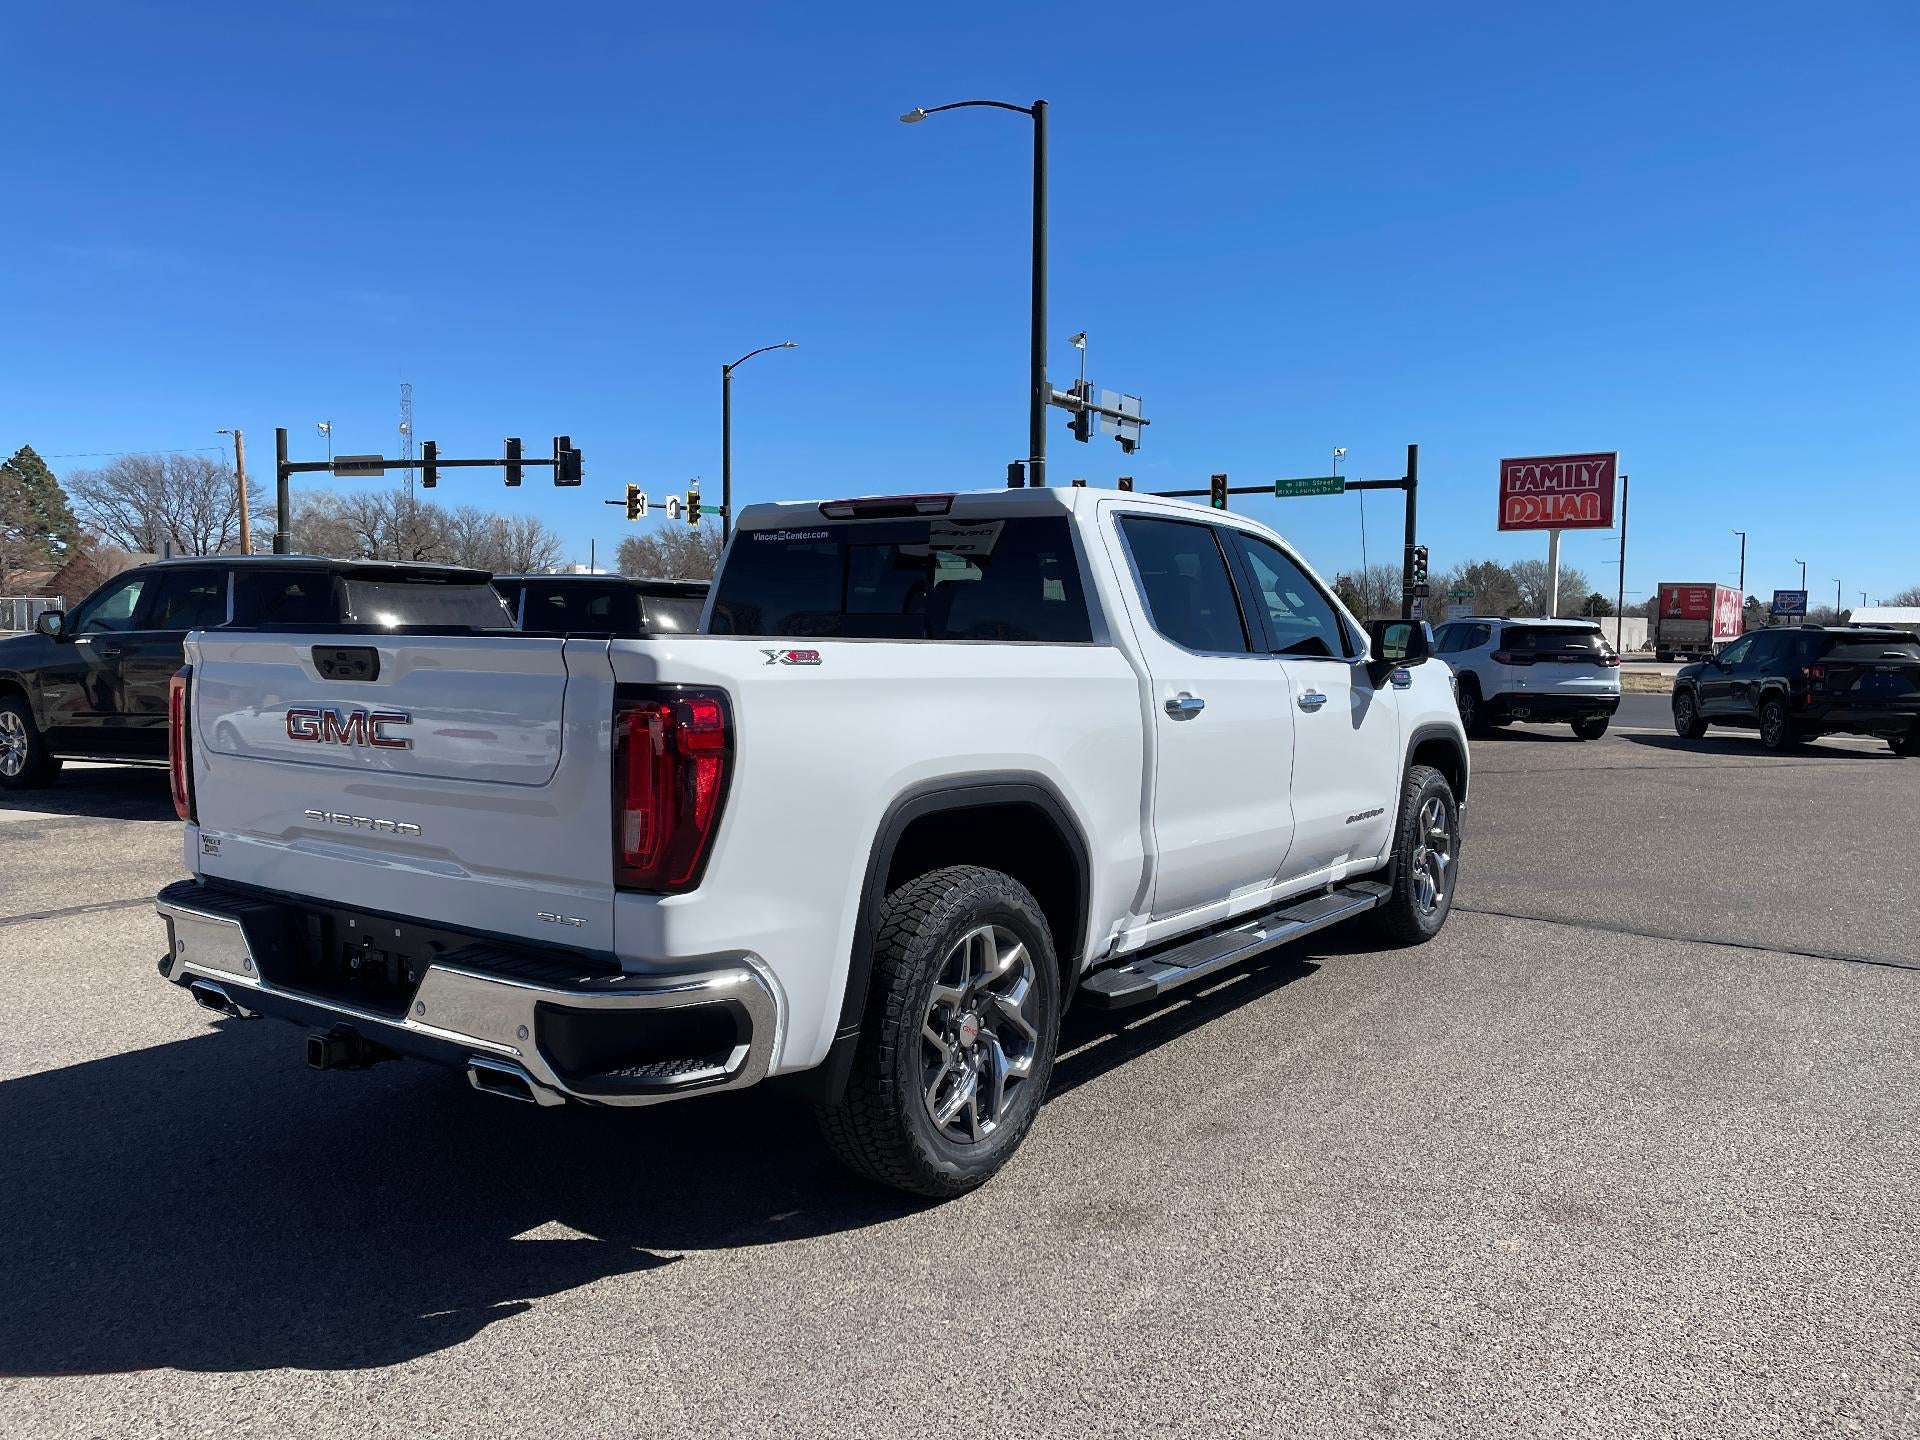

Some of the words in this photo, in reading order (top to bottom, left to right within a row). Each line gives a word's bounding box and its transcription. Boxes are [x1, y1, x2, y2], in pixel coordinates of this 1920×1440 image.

[1507, 460, 1606, 493] FAMILY
[1295, 487, 1321, 495] Lounge
[1505, 491, 1600, 524] DOLLAR
[286, 706, 414, 750] GMC
[304, 809, 421, 836] SIERRA
[537, 911, 588, 928] SLT
[962, 1024, 978, 1037] GMC
